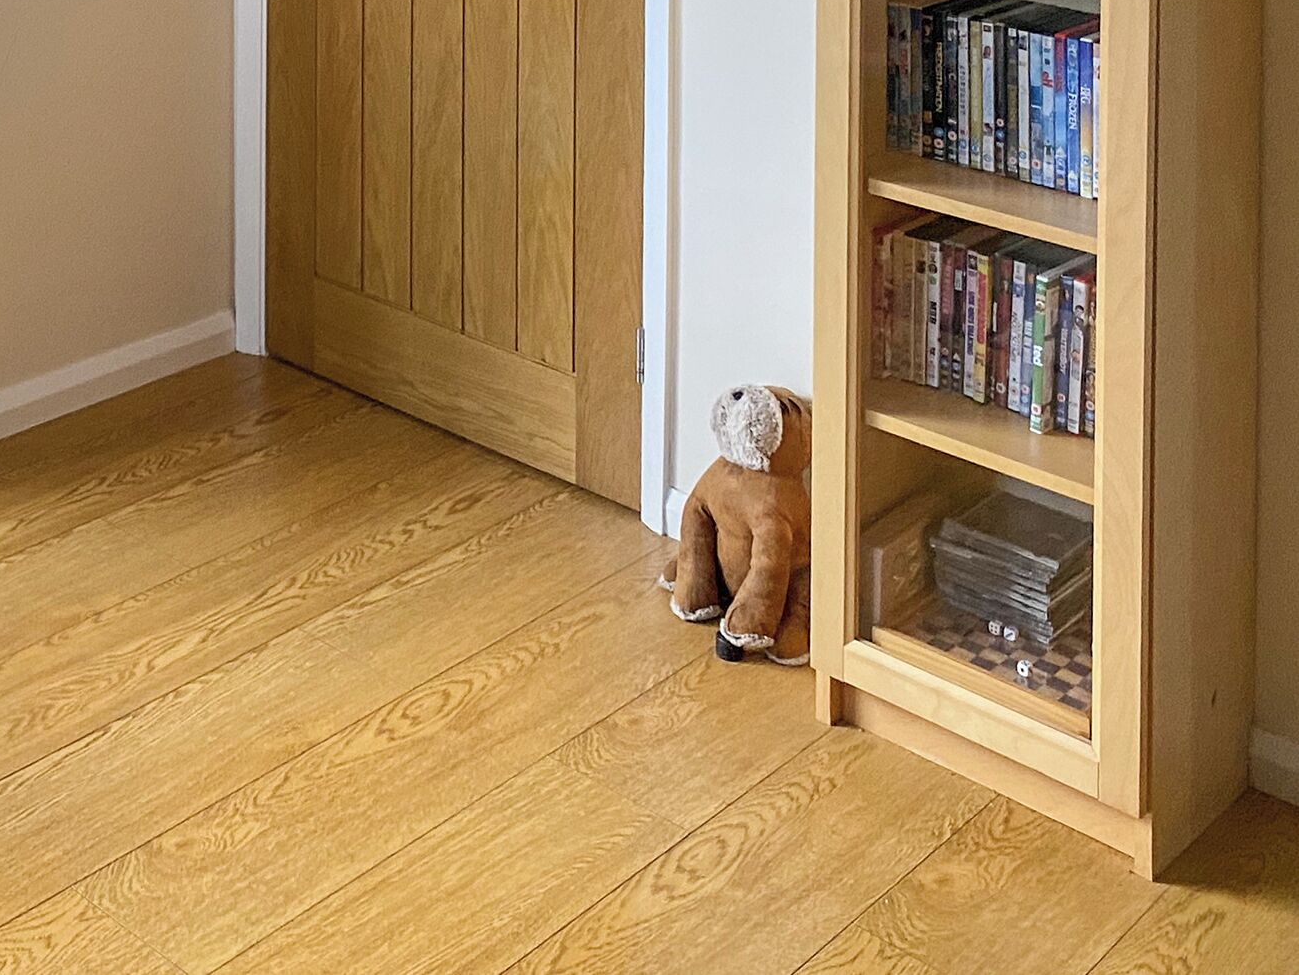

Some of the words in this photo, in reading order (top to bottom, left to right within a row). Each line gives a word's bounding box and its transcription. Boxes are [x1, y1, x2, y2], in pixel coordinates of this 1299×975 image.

[935, 41, 943, 113] PREDESTINATION
[1068, 92, 1077, 131] FROZEN
[1033, 345, 1043, 367] ted
